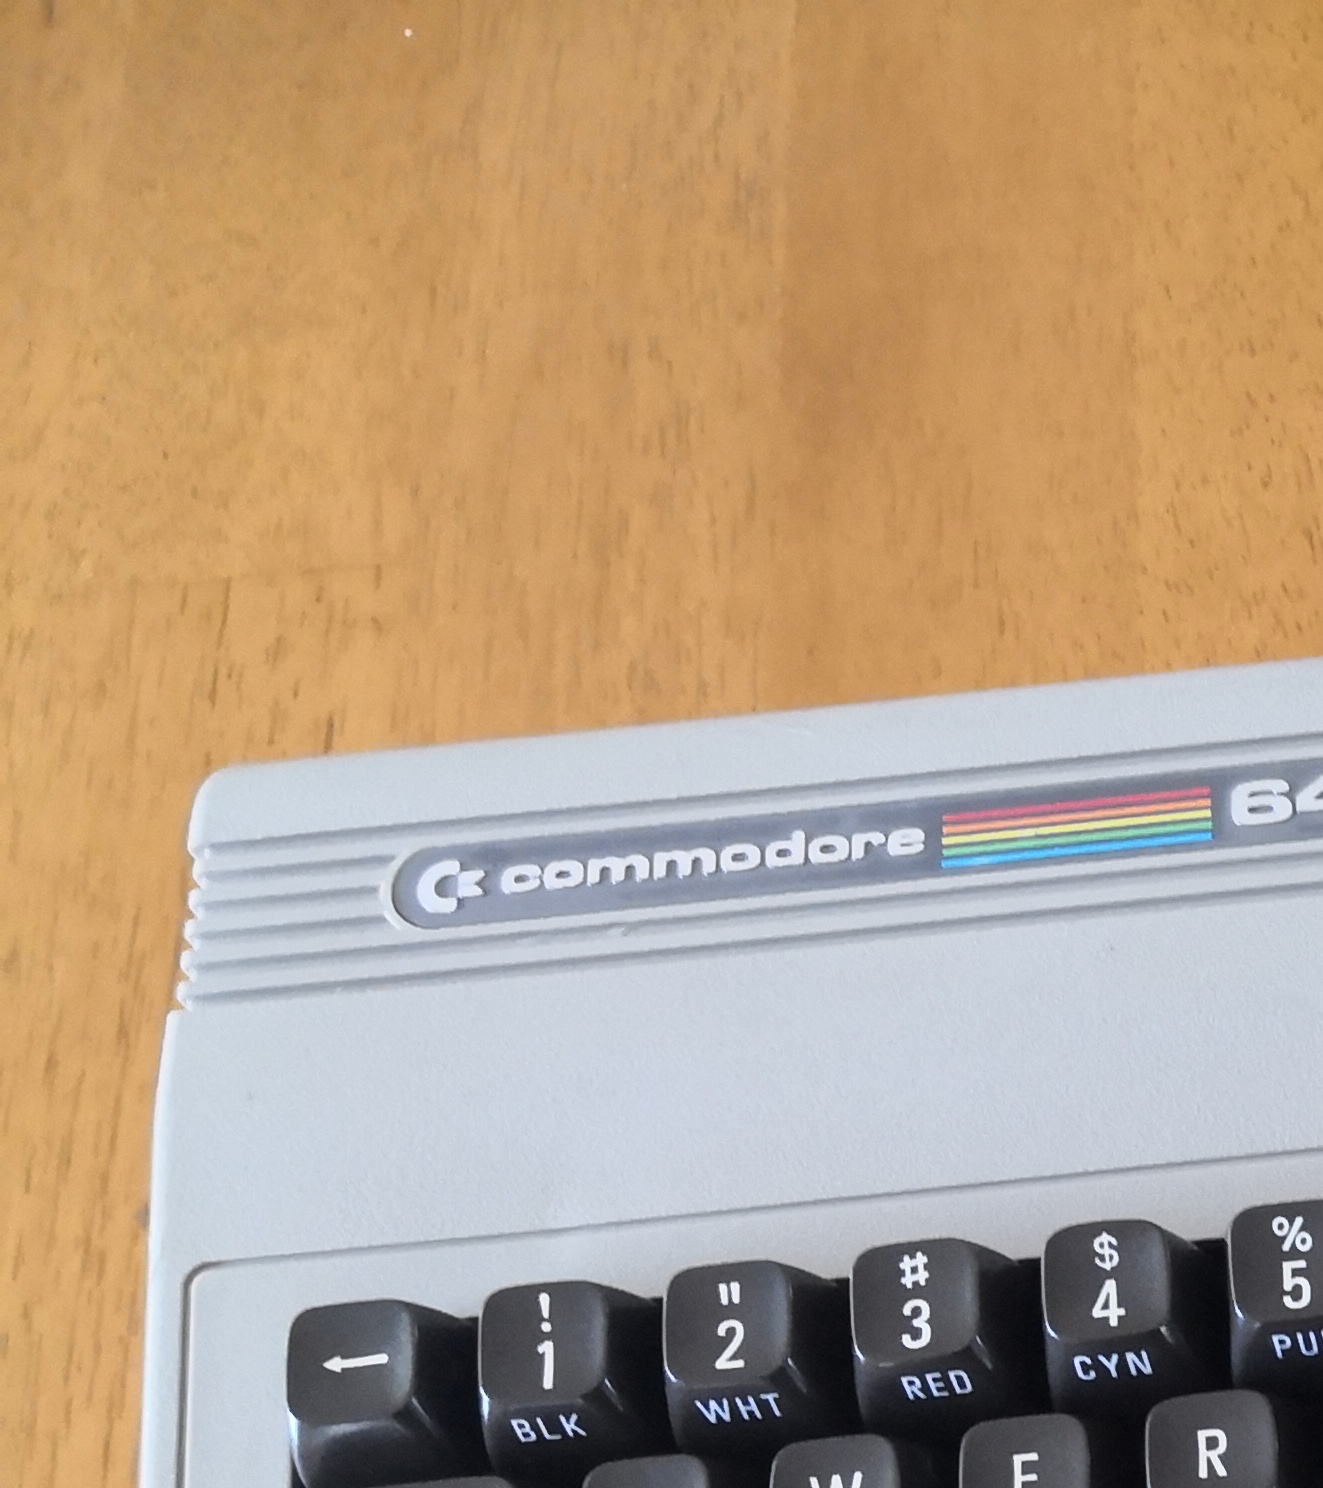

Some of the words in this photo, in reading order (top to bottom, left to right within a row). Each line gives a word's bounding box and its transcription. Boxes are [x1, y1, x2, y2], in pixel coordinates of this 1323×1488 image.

[500, 828, 926, 896] commodore
[1092, 1231, 1120, 1271] $
[1271, 1215, 1313, 1253] %
[898, 1251, 930, 1289] #
[1282, 1259, 1312, 1310] 5
[538, 1292, 552, 1333] !
[1091, 1278, 1126, 1327] 4
[714, 1318, 745, 1370] 2
[901, 1298, 932, 1350] 3
[537, 1340, 555, 1390] 1
[900, 1369, 973, 1400] RED
[1073, 1349, 1153, 1381] CYN
[510, 1413, 587, 1443] BLK
[694, 1392, 782, 1424] WHT
[1197, 1428, 1228, 1479] R
